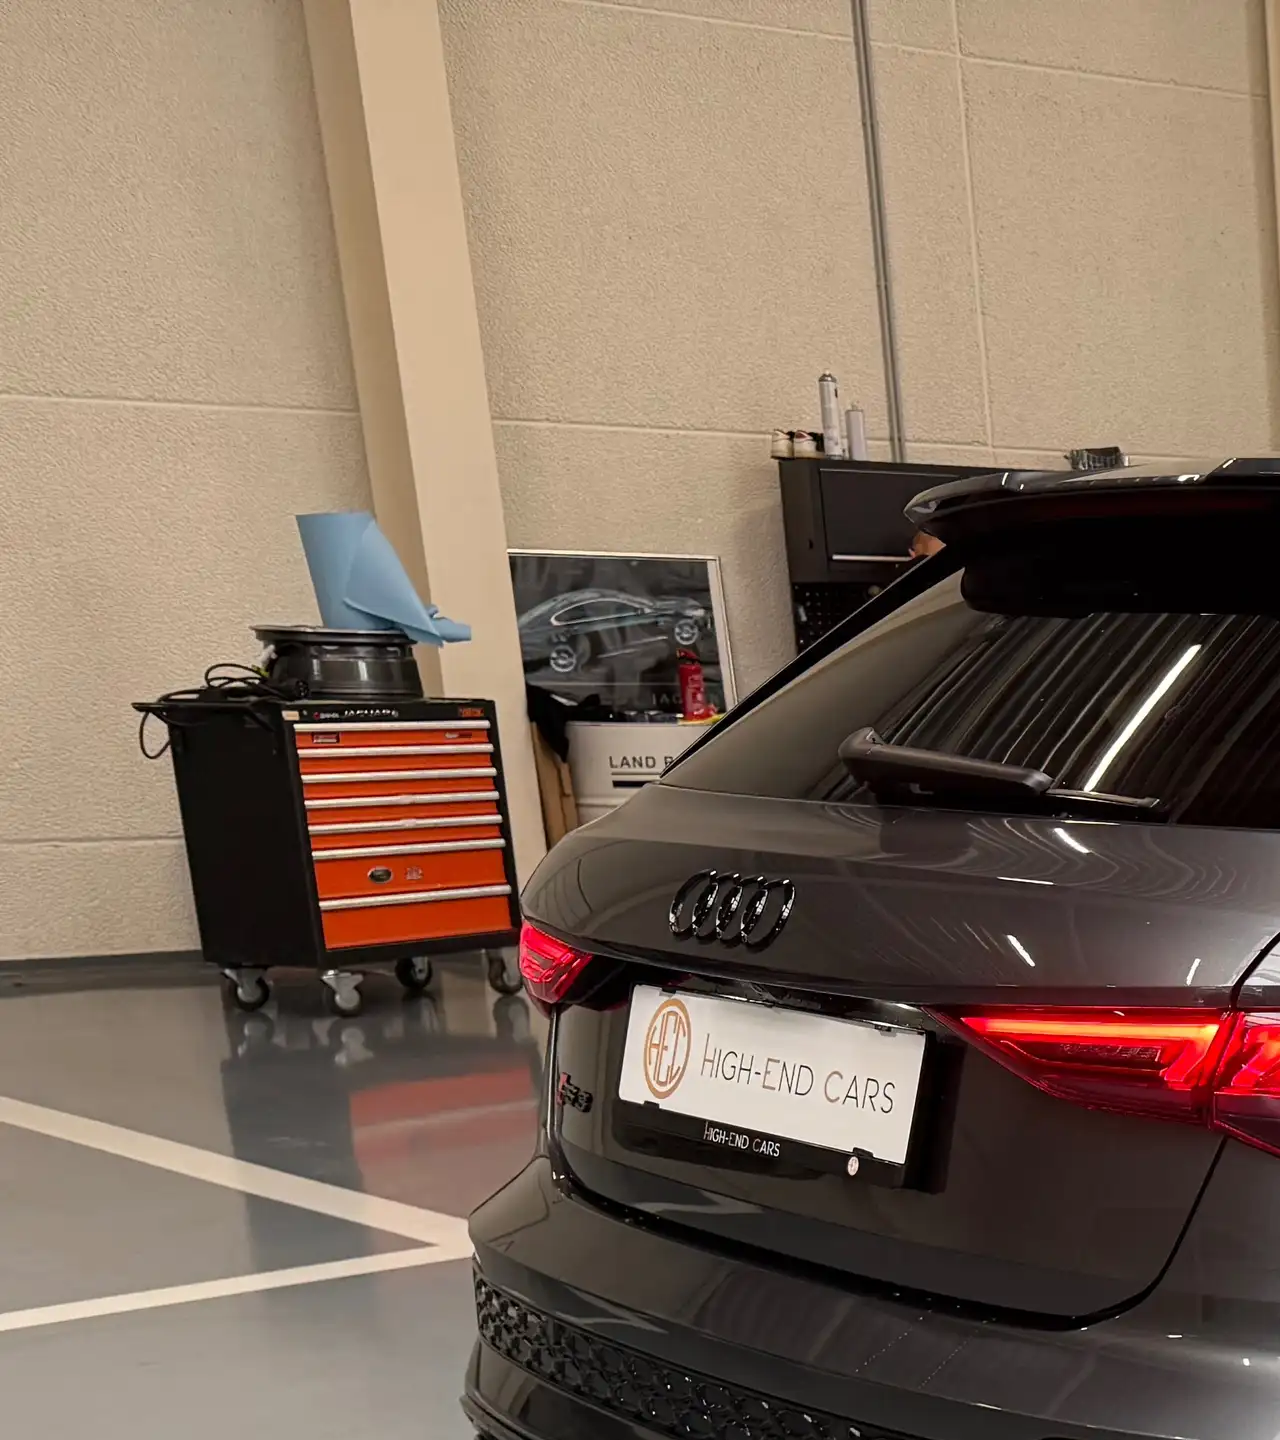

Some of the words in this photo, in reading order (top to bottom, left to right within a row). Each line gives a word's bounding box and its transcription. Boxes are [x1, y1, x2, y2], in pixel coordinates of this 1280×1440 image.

[609, 756, 656, 769] LAND
[701, 1033, 814, 1096] HIGH-END
[824, 1070, 896, 1114] CARS
[703, 1121, 750, 1149] HIGH-END
[752, 1138, 781, 1157] CARS
